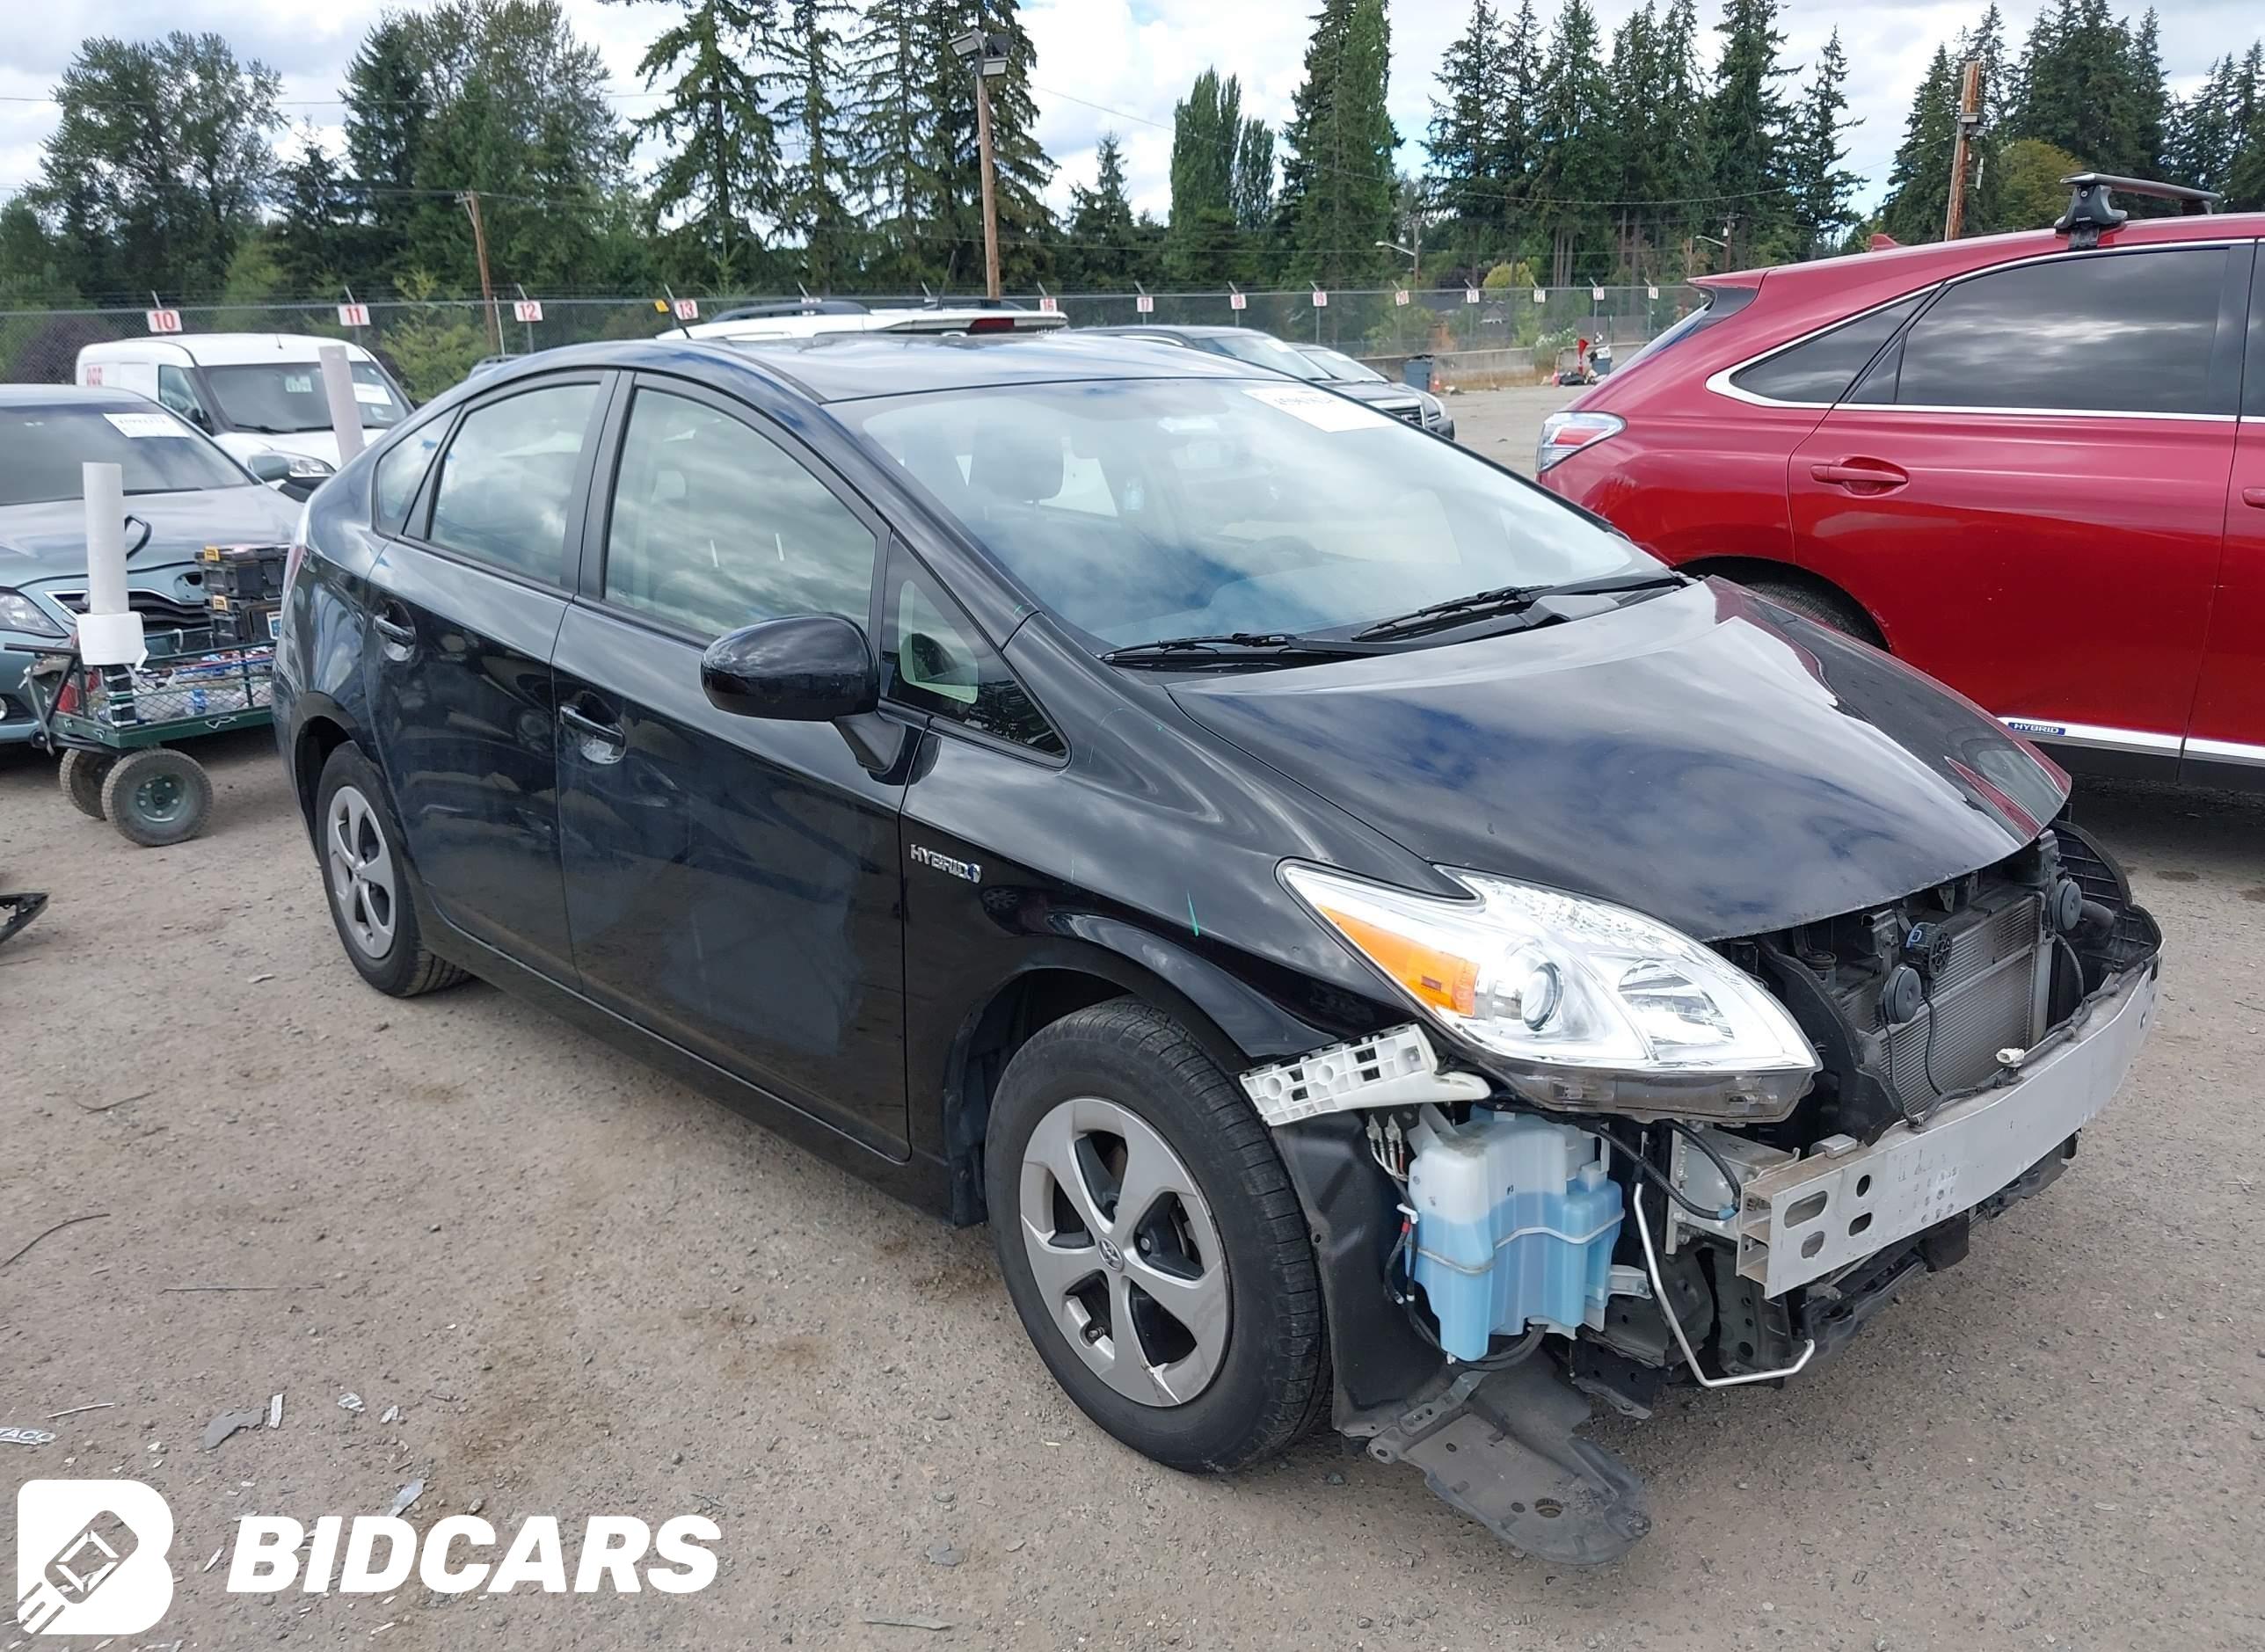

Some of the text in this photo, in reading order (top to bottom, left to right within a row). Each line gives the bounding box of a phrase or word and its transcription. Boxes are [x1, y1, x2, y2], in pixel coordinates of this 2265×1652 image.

[346, 308, 362, 324] 11
[521, 304, 537, 321] 12
[680, 302, 694, 318] 13
[153, 312, 175, 330] 10
[2014, 724, 2058, 733] HYBRID
[910, 844, 968, 879] HYBRID
